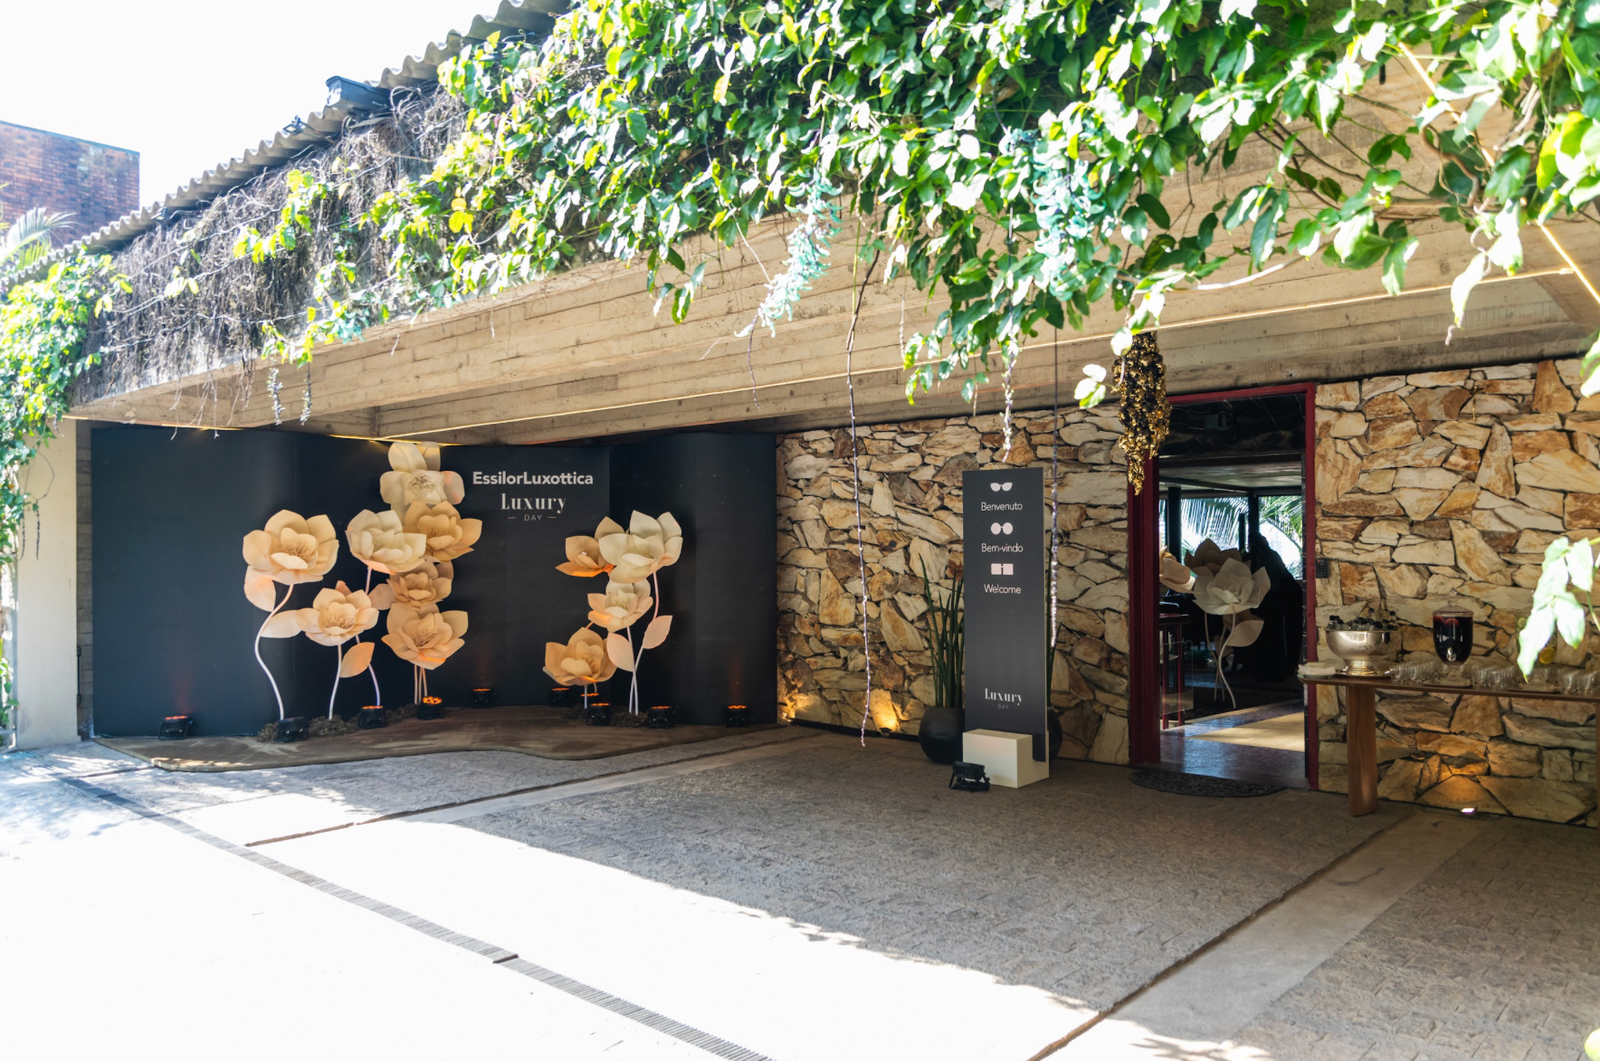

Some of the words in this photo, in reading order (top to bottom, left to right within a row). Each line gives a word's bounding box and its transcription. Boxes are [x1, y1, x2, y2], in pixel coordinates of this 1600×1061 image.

[472, 471, 594, 485] EssilorLuxottica
[501, 493, 567, 514] Luxury
[981, 502, 1023, 511] Benvenuto
[524, 514, 543, 522] DAY
[981, 543, 1024, 553] Bem-vindo
[983, 584, 1022, 594] Welcome
[984, 688, 1023, 706] Luxury
